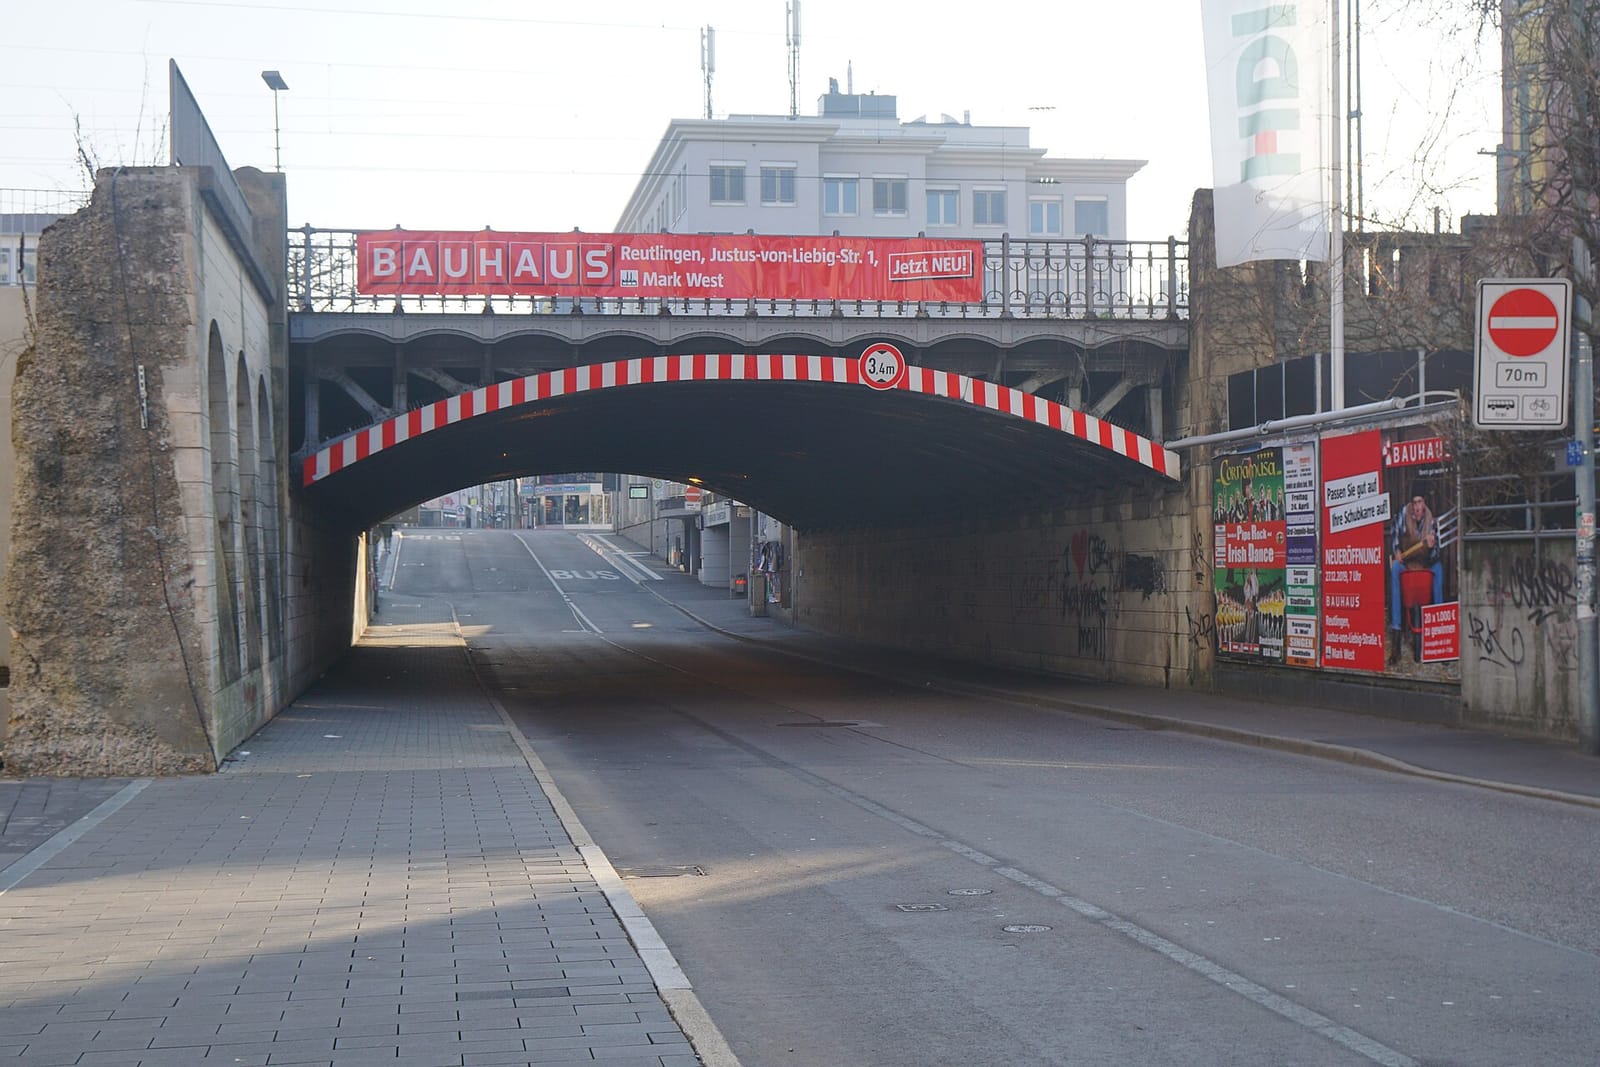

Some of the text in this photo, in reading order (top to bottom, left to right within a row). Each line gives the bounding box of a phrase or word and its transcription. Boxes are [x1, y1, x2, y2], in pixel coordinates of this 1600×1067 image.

[373, 247, 609, 279] BAUHAUS
[621, 245, 879, 267] Reutlingen, Justus-von-Liebig-Str. 1,
[893, 255, 967, 275] Jetzt NEU!
[643, 271, 724, 288] Mark West
[1327, 477, 1377, 501] Passen Sie gut auf
[1332, 513, 1343, 527] Ihre
[1344, 506, 1375, 524] Schubkarre
[1227, 543, 1247, 563] Irish
[1248, 543, 1274, 563] Dance
[1325, 545, 1381, 565] NEUERÖFFNUNG!
[549, 570, 620, 579] BUS
[1325, 595, 1360, 607] BAUHAUS
